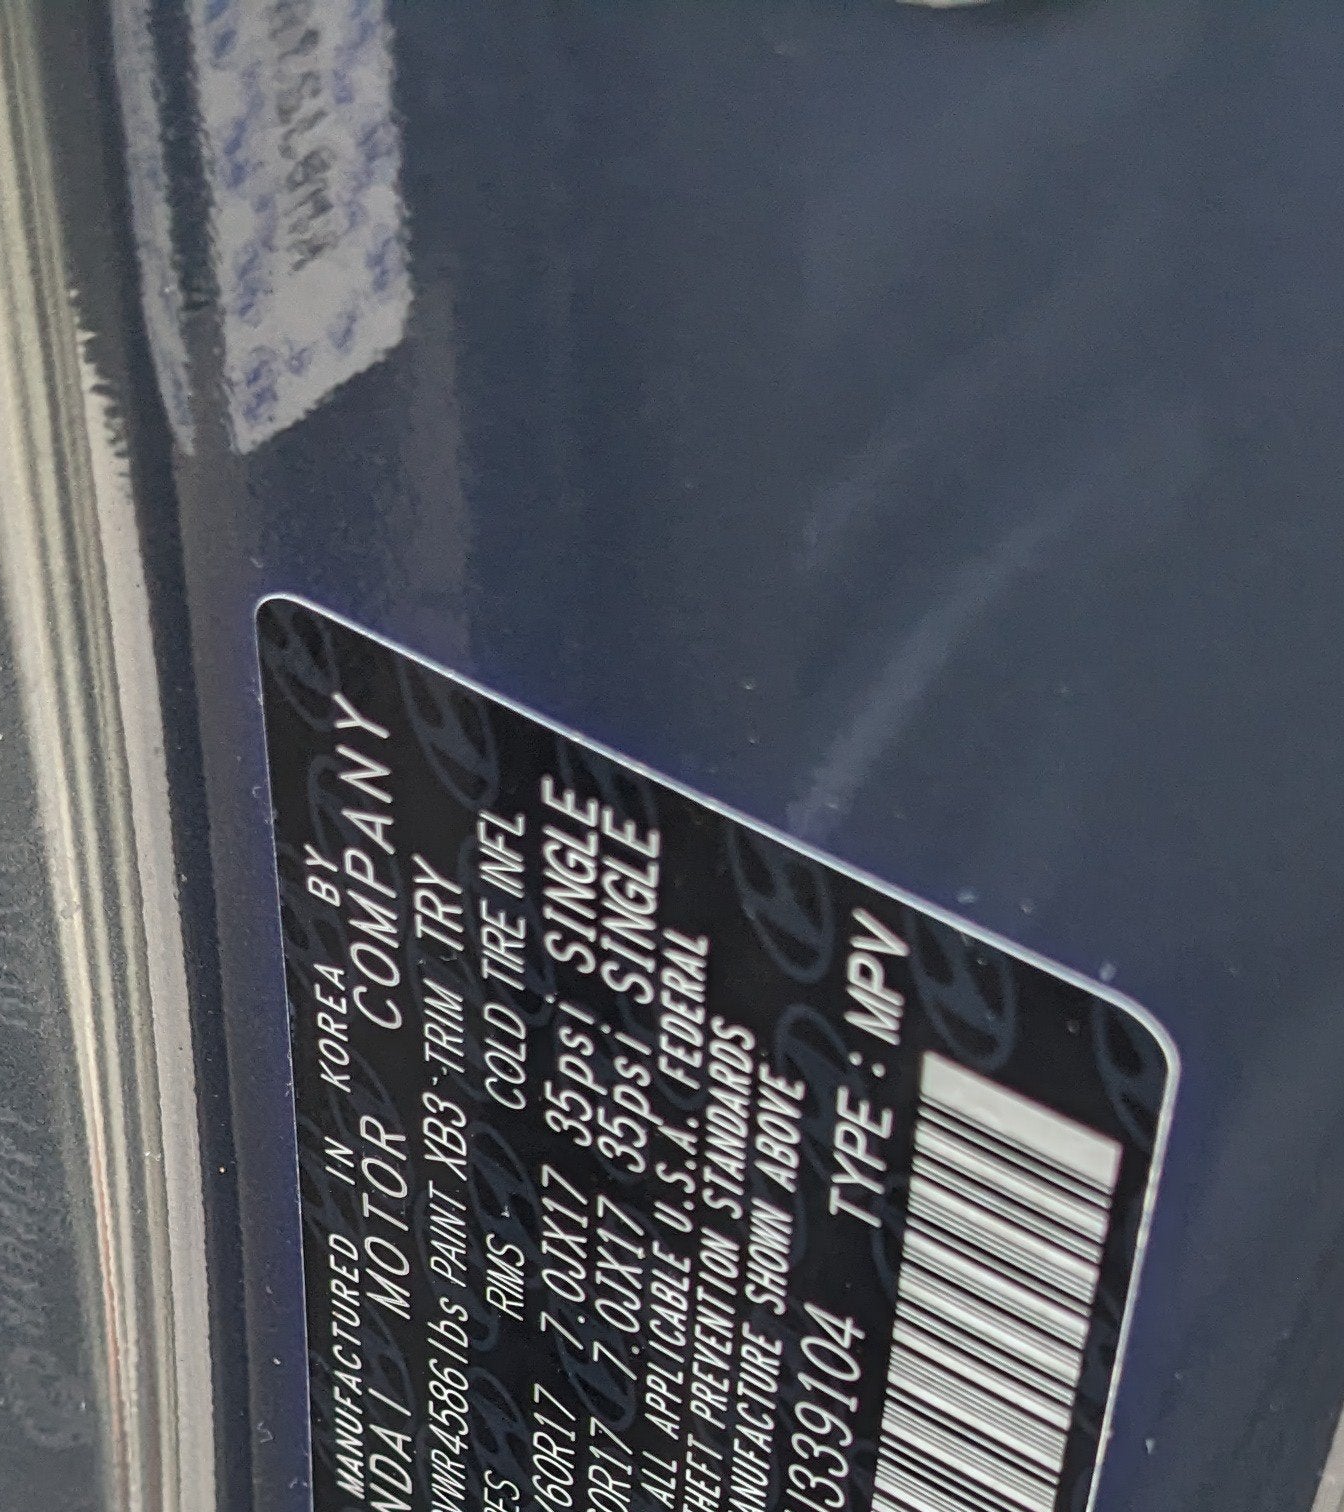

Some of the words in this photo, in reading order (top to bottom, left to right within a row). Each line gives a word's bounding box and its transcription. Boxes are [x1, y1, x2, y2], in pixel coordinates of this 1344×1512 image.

[303, 843, 341, 907] BY
[331, 691, 402, 1030] COMPANY
[412, 853, 464, 952] TRY
[476, 809, 525, 899] INFL
[540, 775, 599, 974] SINGLE
[599, 806, 660, 1005] SINGLE
[479, 898, 526, 991] TIRE
[843, 907, 909, 1046] MPV
[312, 962, 351, 1093] KOREA
[421, 977, 465, 1074] TRIM
[482, 1002, 526, 1110] COLD
[657, 928, 708, 1090] FEDERAL
[323, 1135, 356, 1186] IN
[420, 1091, 467, 1182] XB3
[653, 1116, 699, 1233] U.S.A.
[701, 1015, 755, 1220] STANDARDS
[753, 1063, 805, 1193] ABOVE
[358, 1113, 411, 1320] MOTOR
[427, 1179, 467, 1288] PAINT
[744, 1197, 793, 1315] SHOWN
[484, 1232, 525, 1322] RIMS
[688, 1226, 740, 1430] PREVENTION
[327, 1232, 365, 1499] MANUFACTURED
[643, 1239, 691, 1441] APPLICABLE
[639, 1449, 678, 1510] ALL
